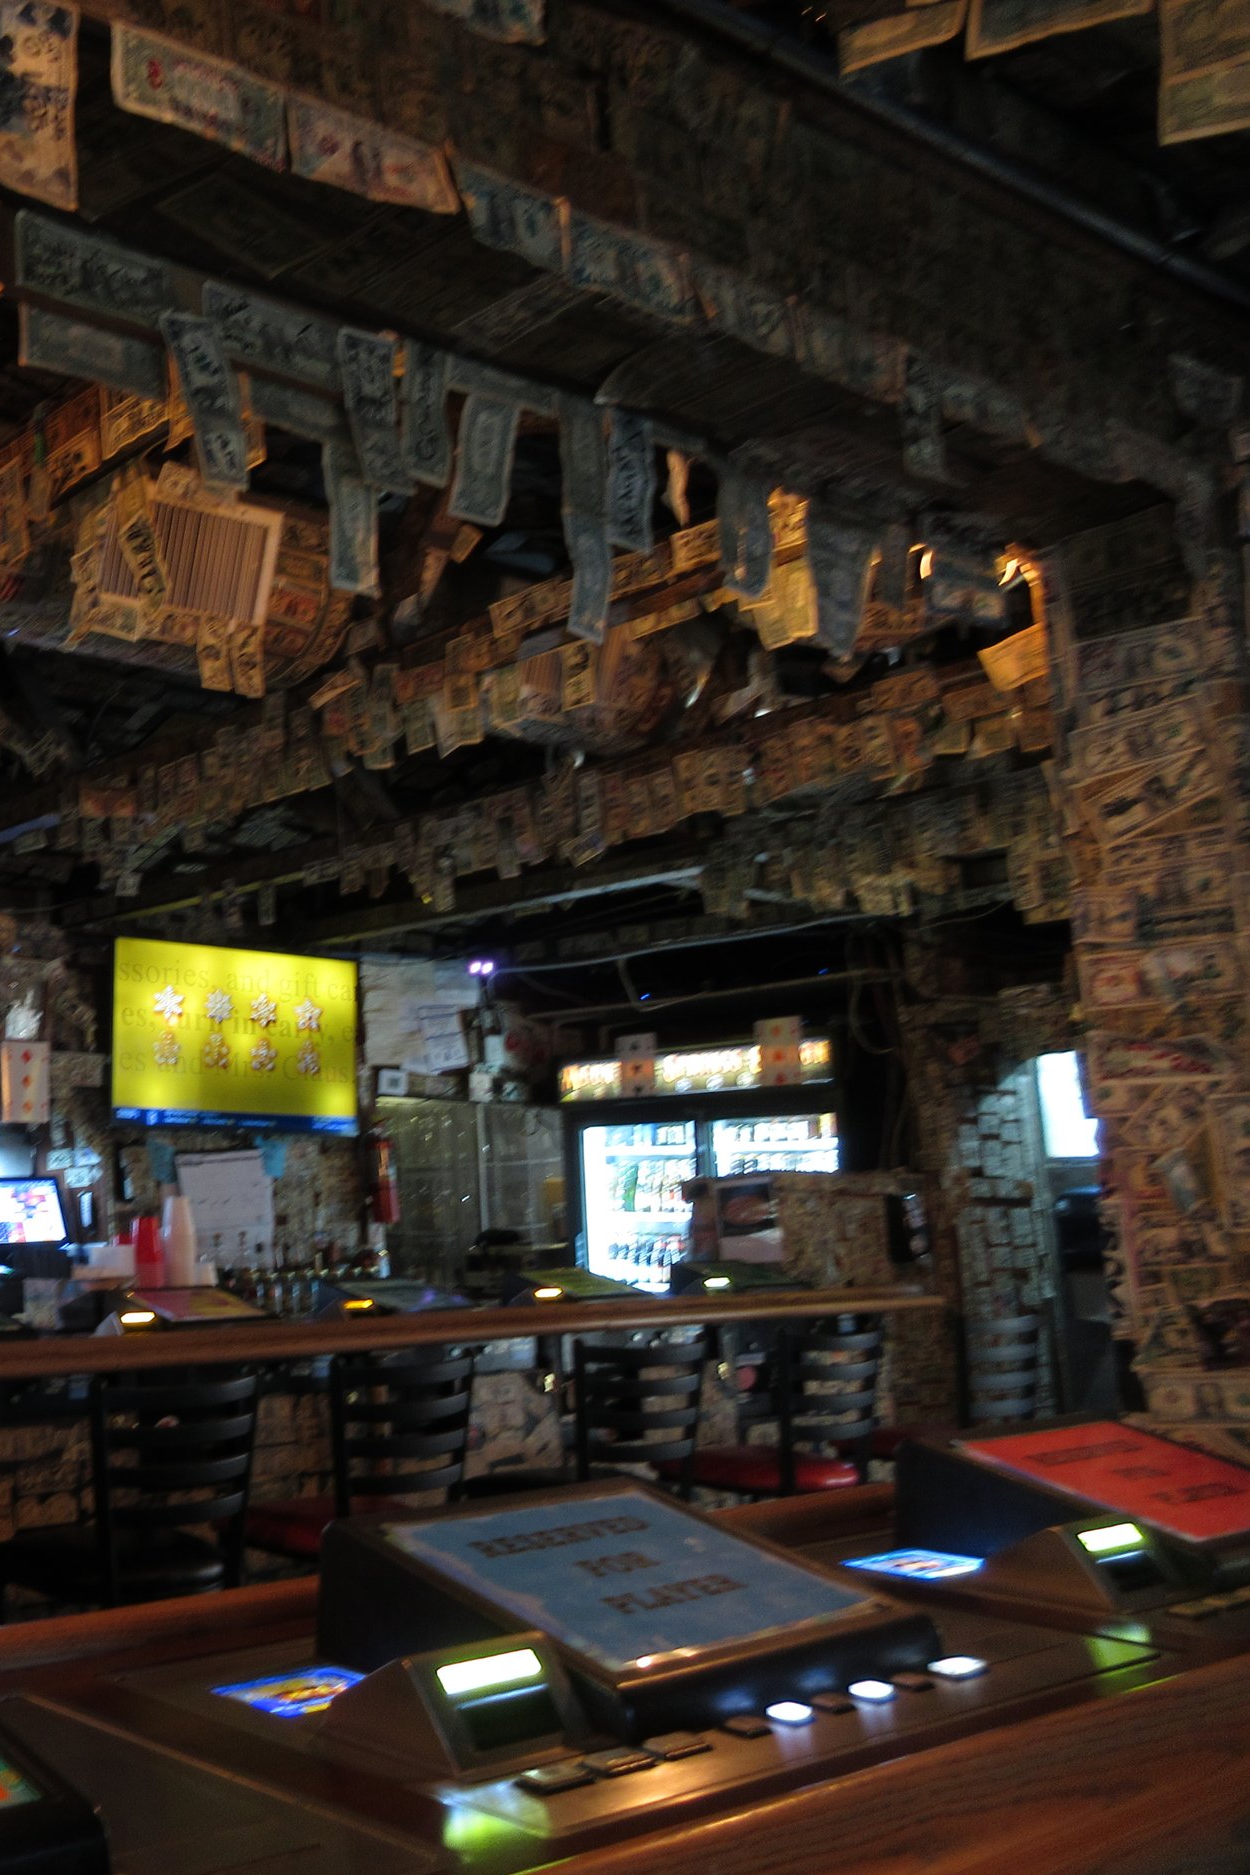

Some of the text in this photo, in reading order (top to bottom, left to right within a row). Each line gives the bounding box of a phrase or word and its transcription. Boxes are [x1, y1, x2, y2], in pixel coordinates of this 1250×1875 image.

[225, 969, 270, 993] and
[280, 971, 320, 1003] gift
[327, 983, 357, 1001] ca
[167, 1010, 224, 1034] urn
[267, 1014, 335, 1046] eay,
[467, 1514, 651, 1560] RESERVED
[573, 1550, 661, 1578] FOR
[599, 1572, 749, 1615] PLAYER
